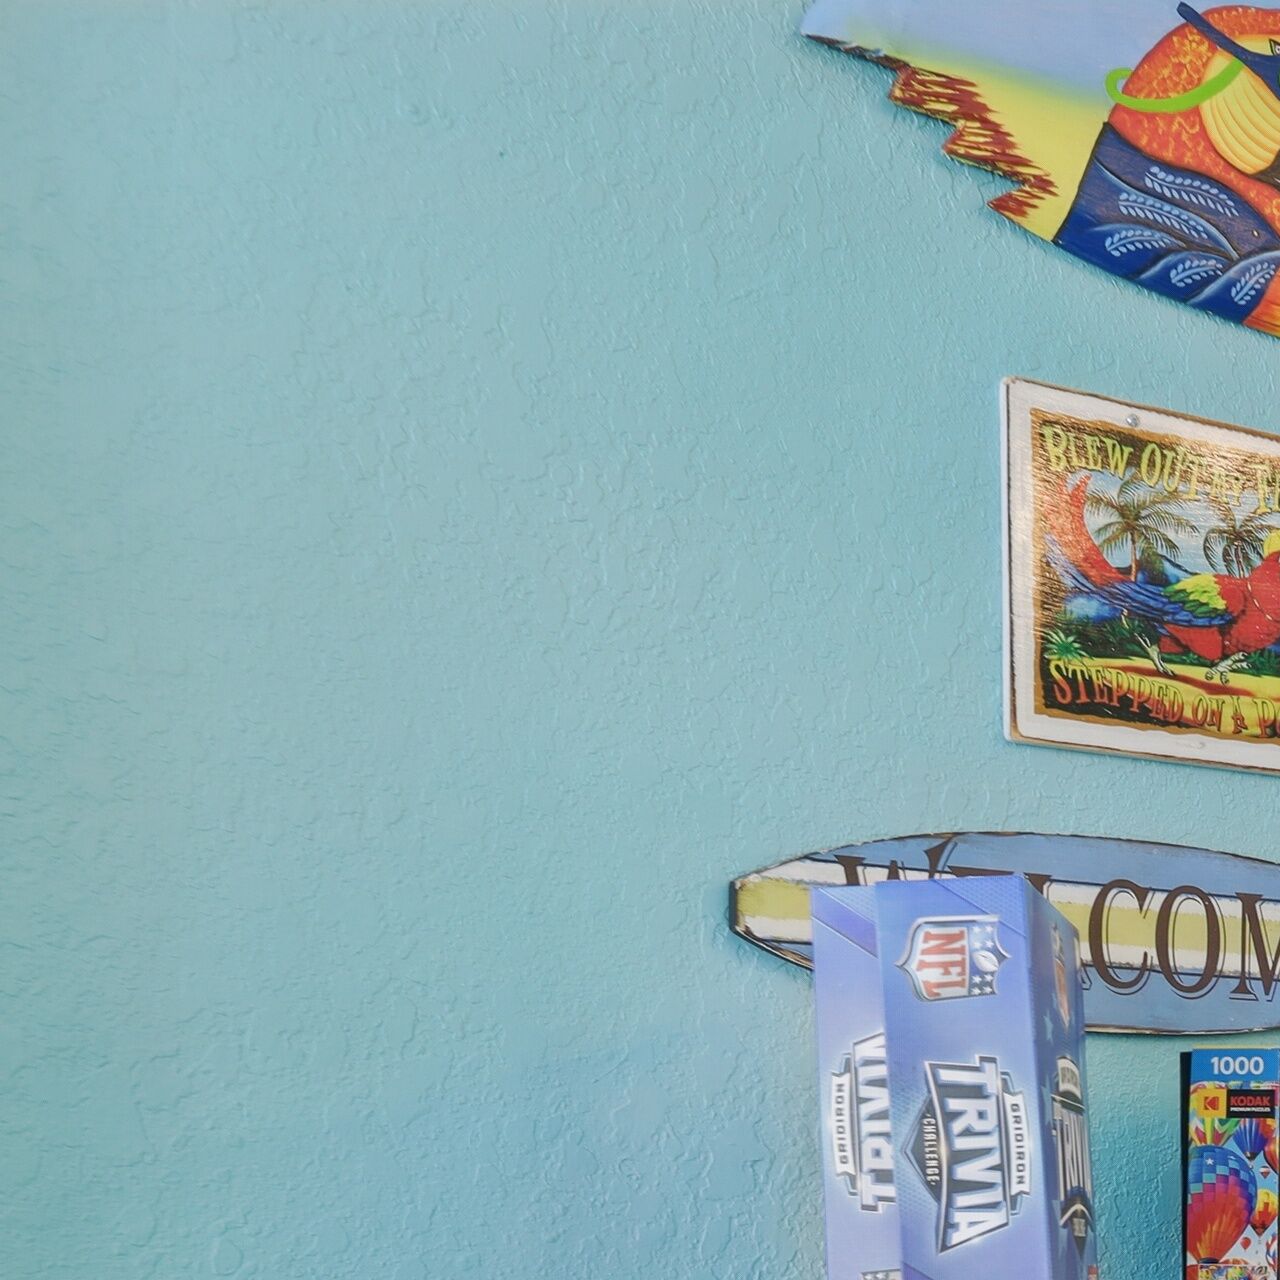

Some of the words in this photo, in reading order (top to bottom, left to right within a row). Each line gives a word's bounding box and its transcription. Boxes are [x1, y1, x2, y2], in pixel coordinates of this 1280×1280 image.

[1041, 424, 1134, 480] BLEW
[1140, 442, 1207, 499] OUT
[1050, 660, 1184, 723] STEPPED
[1191, 693, 1226, 732] ON
[1231, 695, 1249, 735] A
[915, 929, 966, 998] NFL
[1211, 1056, 1264, 1075] 1000
[1230, 1096, 1270, 1107] KODAK
[834, 1083, 850, 1165] GRIDIRON
[922, 1116, 940, 1183] CHALLENGE
[936, 1060, 1008, 1248] TRIVIA
[1010, 1102, 1026, 1185] GRIDIRON
